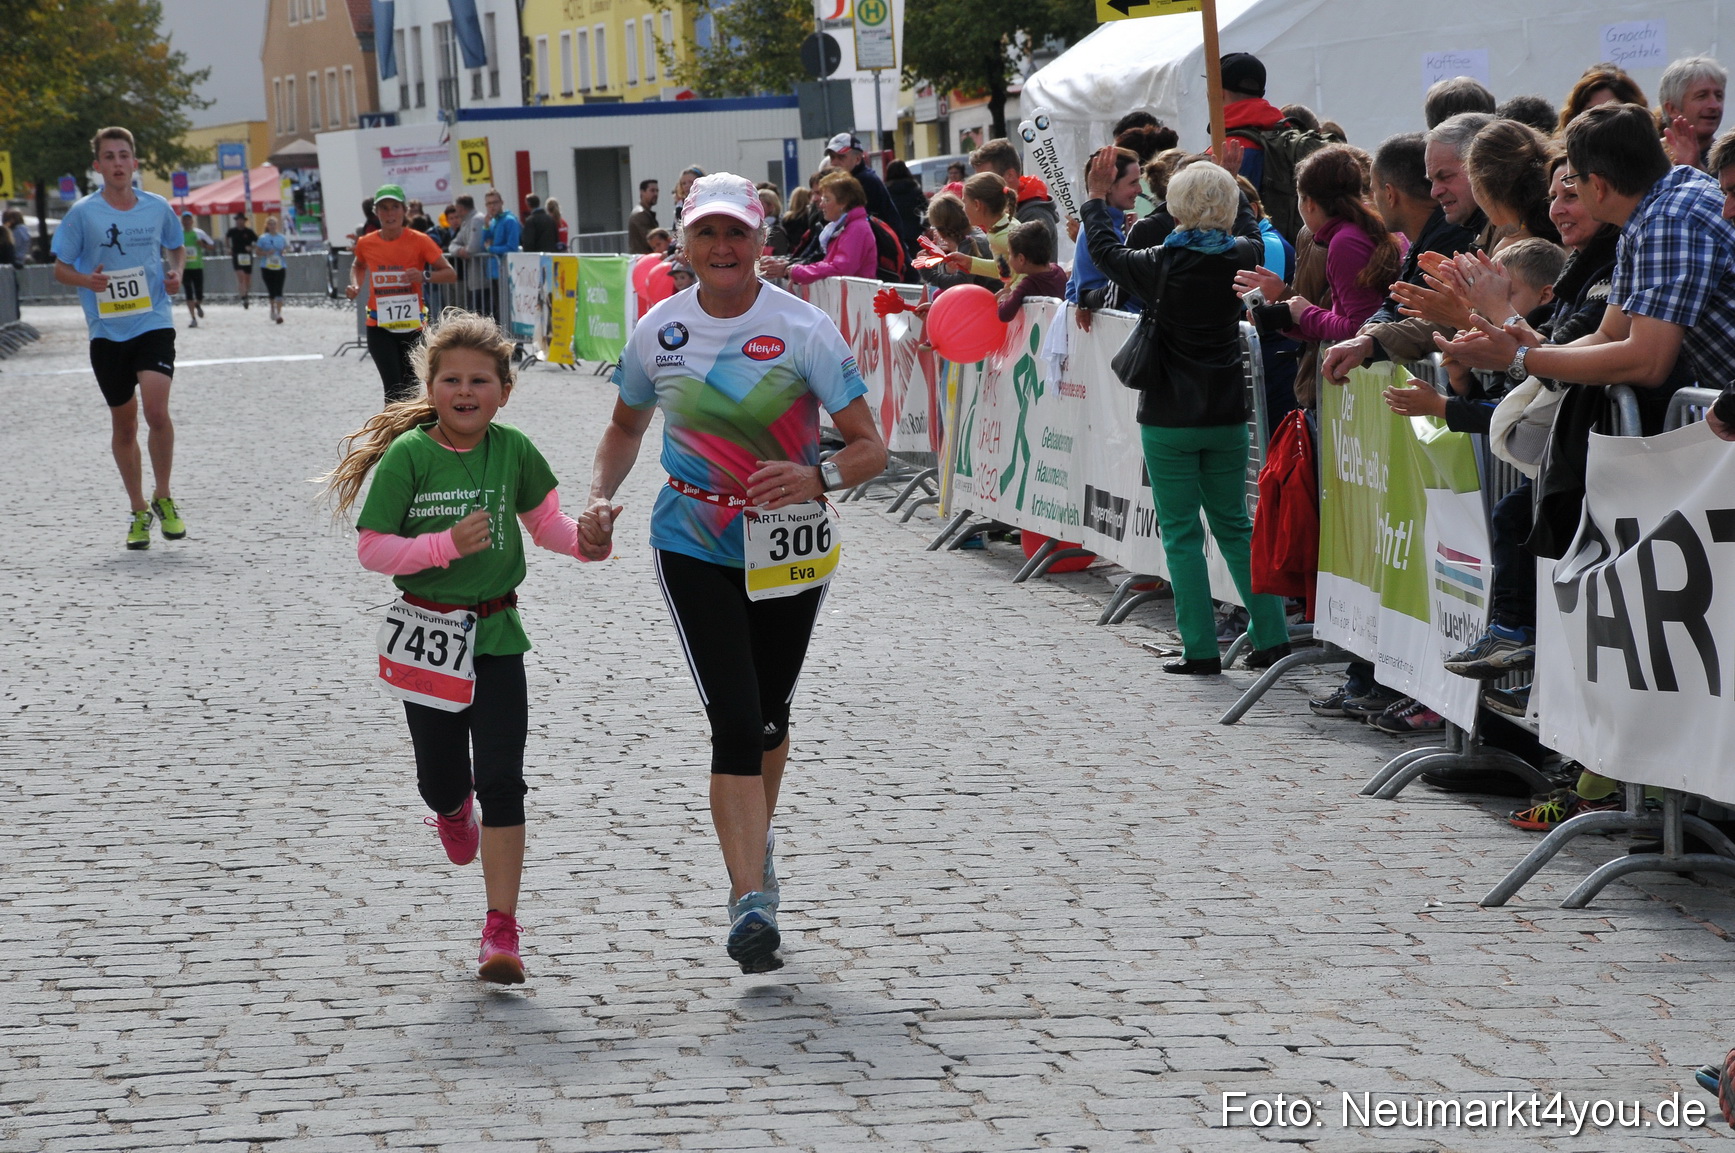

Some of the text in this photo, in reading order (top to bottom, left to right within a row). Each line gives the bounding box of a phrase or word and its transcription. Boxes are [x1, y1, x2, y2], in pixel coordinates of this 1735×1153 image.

[1605, 25, 1659, 43] Gnocchi
[1425, 54, 1471, 70] Kaffee
[467, 152, 484, 175] D
[1032, 147, 1053, 180] BMW
[106, 280, 140, 300] 150
[113, 302, 136, 311] Stefan
[386, 304, 412, 321] 172
[748, 342, 780, 354] Hervis
[1341, 384, 1354, 421] Der
[727, 495, 747, 507] Stieg
[408, 504, 468, 518] Stadtlauf
[787, 511, 824, 523] Neuma
[769, 518, 831, 562] 306
[790, 567, 815, 581] Eva
[415, 611, 466, 630] Neumarkt
[386, 616, 468, 672] 7437
